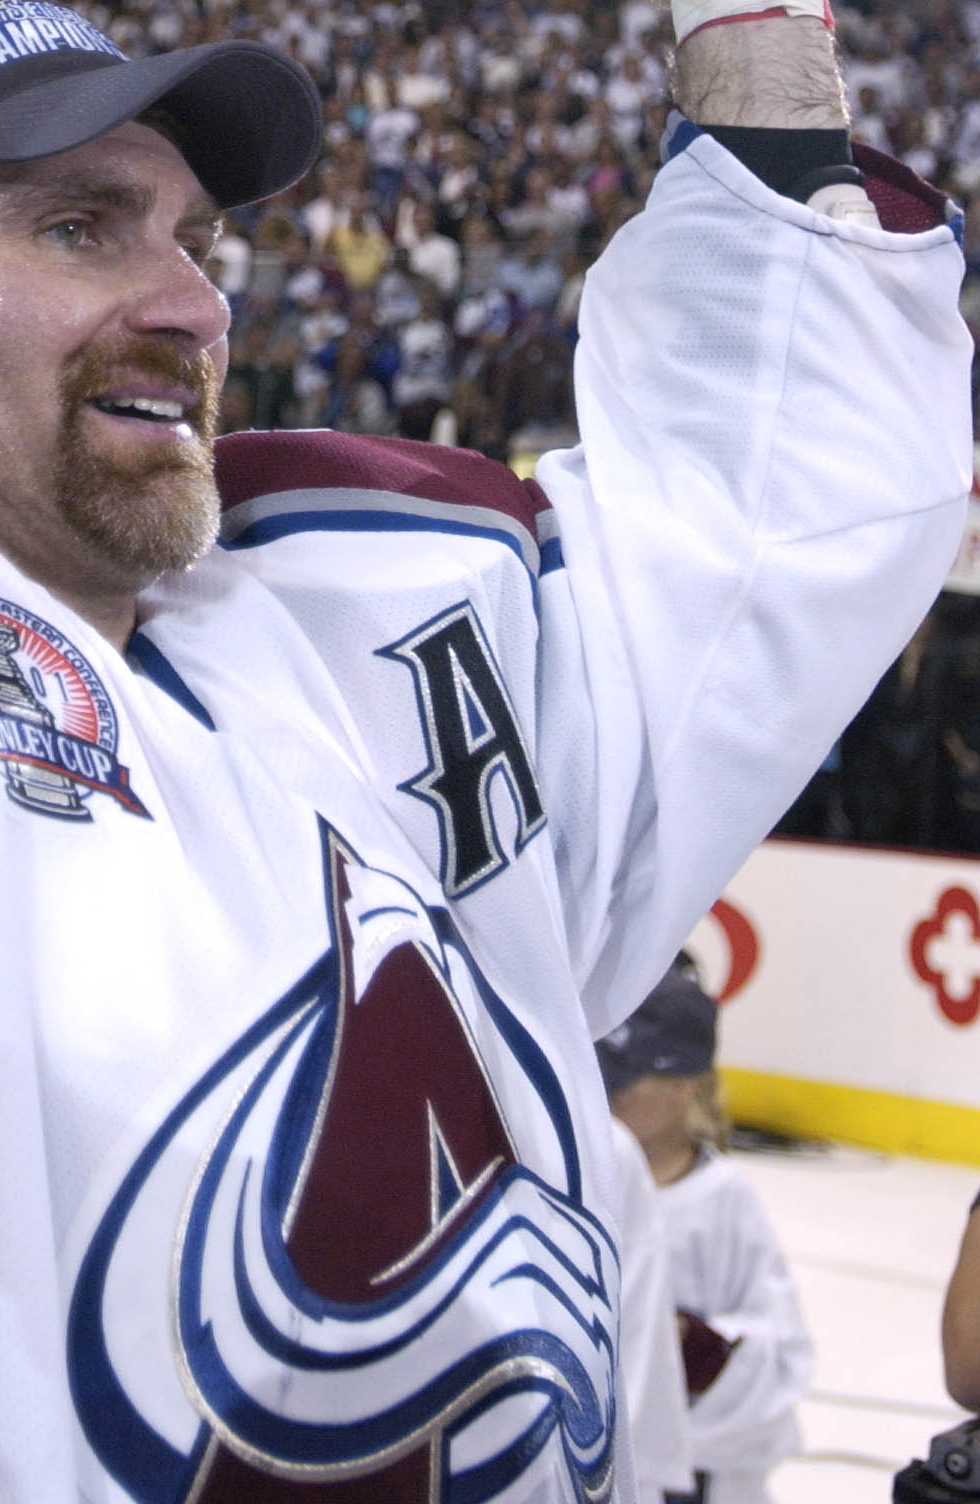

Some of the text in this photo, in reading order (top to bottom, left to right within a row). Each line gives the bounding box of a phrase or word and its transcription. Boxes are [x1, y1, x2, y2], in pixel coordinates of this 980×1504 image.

[63, 649, 114, 750] CONFERENCE
[373, 598, 548, 901] A
[56, 735, 113, 784] CUP
